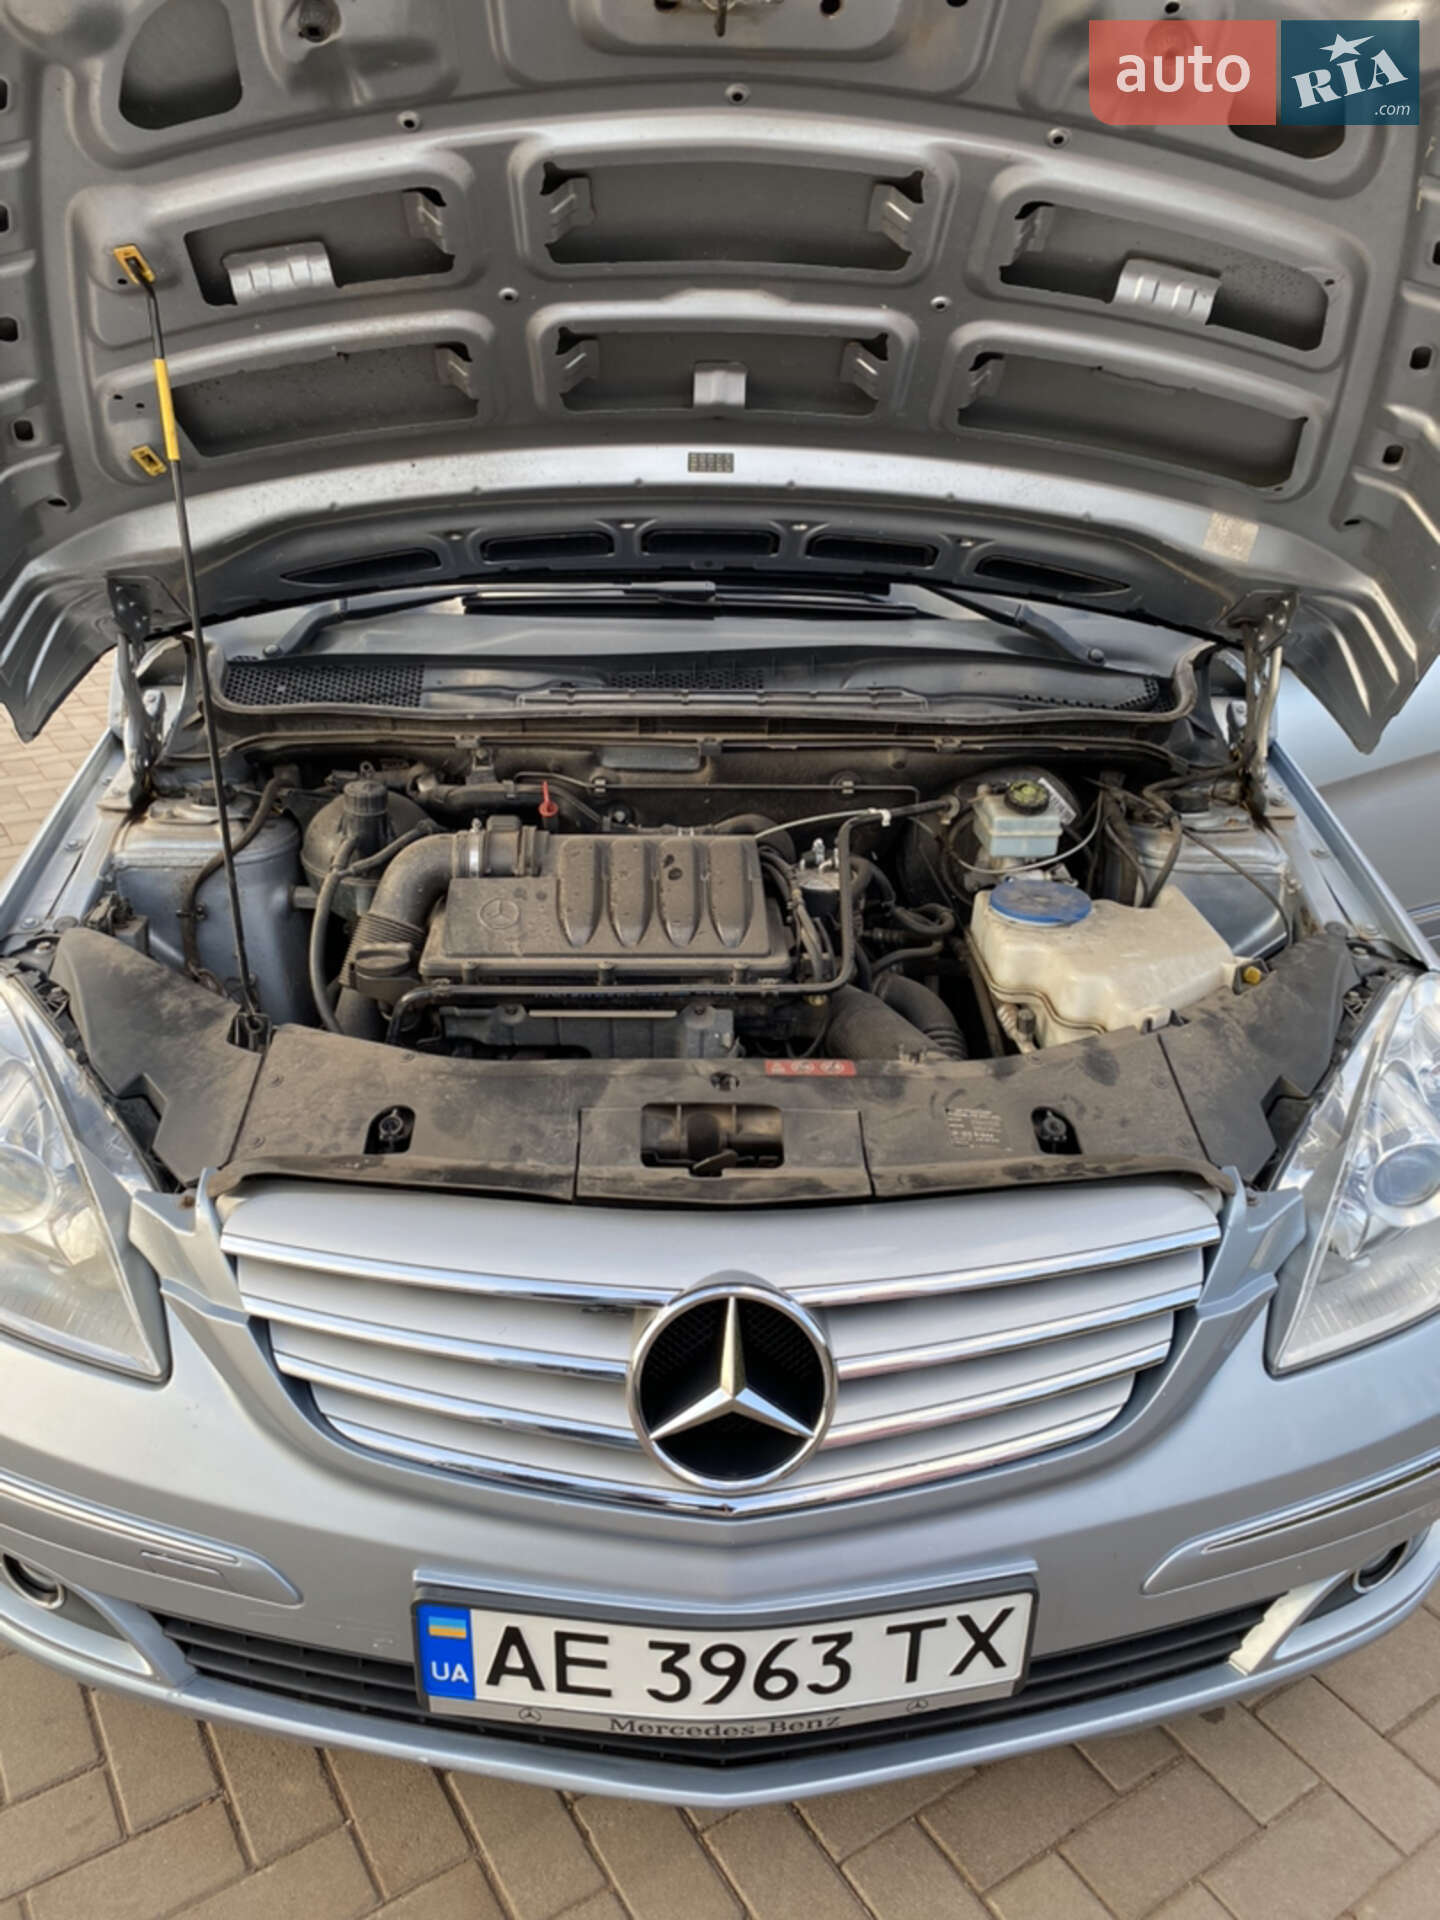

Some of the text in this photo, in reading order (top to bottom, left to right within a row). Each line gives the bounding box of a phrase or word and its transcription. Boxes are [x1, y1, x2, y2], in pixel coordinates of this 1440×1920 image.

[486, 1606, 1017, 1705] AE 3963 TX
[431, 1661, 470, 1684] UA
[609, 1716, 841, 1738] Mercedes-Benz
